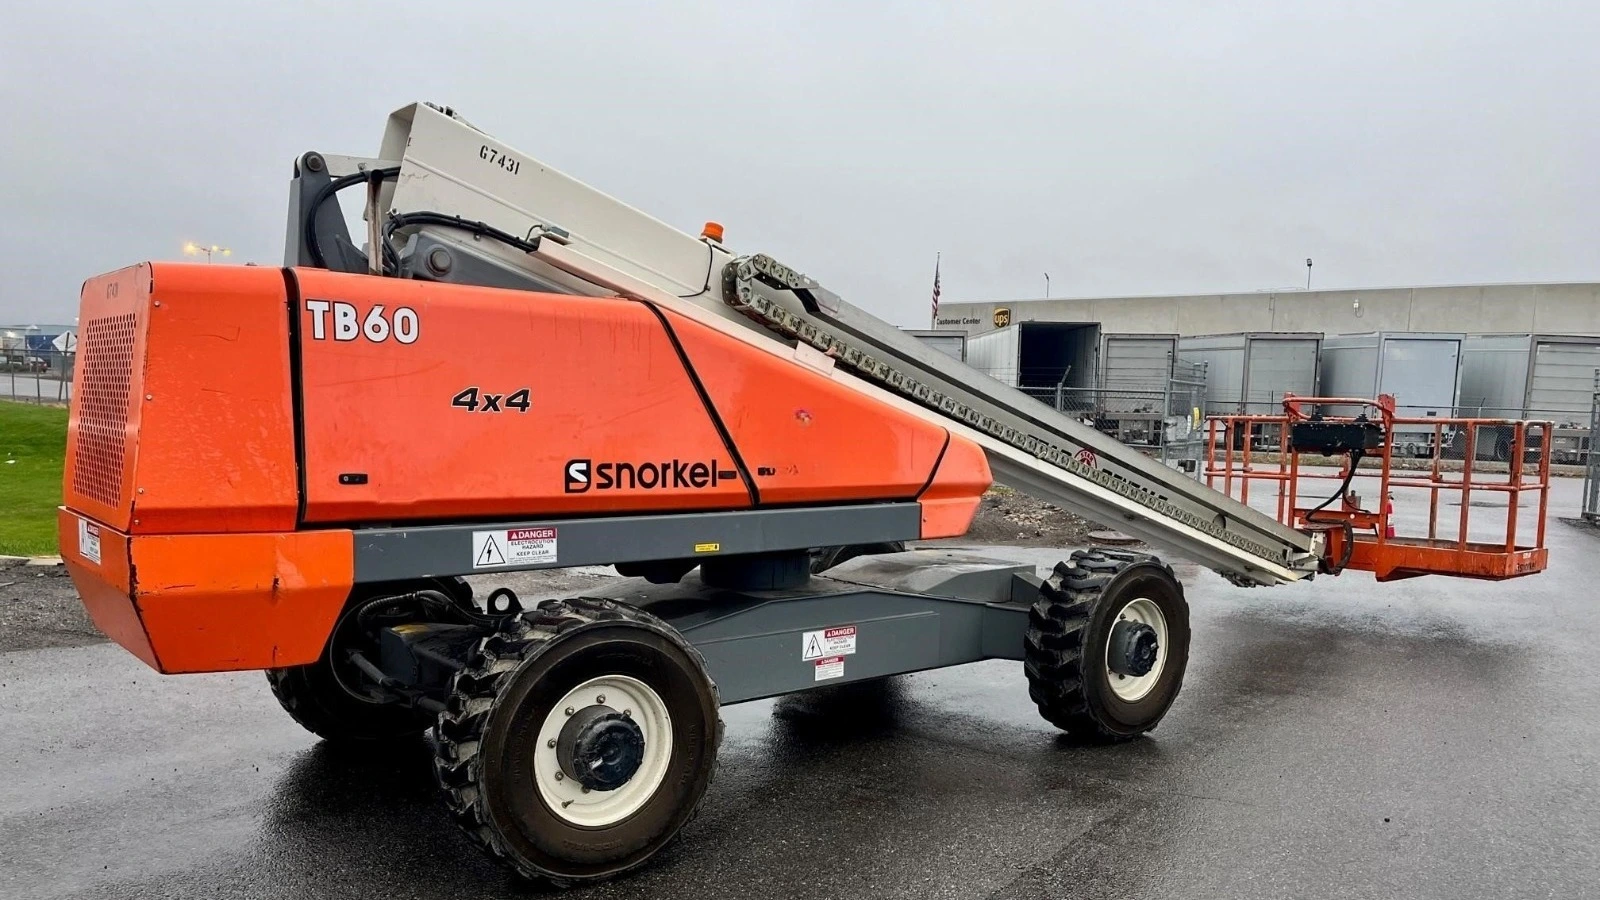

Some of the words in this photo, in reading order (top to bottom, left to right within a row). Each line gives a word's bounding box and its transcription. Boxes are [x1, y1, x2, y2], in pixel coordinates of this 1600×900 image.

[480, 145, 520, 175] G7431
[306, 299, 419, 344] TB60
[994, 315, 1008, 326] ups
[451, 386, 531, 413] 4x4
[596, 459, 717, 489] snorkel
[518, 530, 554, 539] DANGER
[831, 628, 854, 636] DANGER
